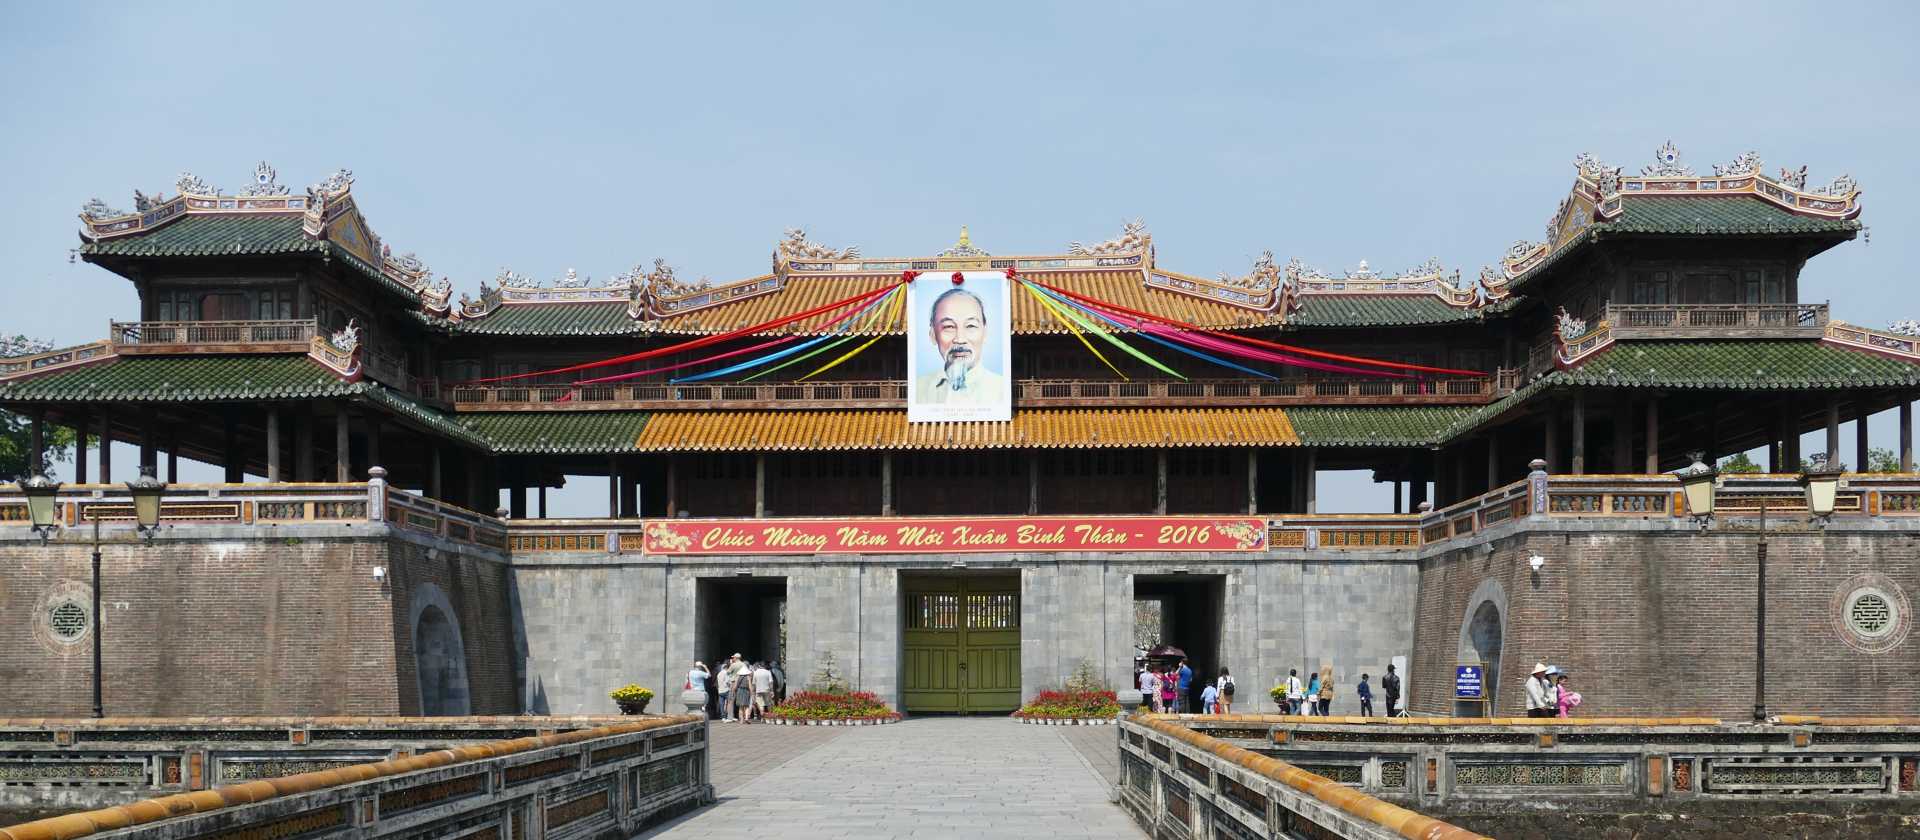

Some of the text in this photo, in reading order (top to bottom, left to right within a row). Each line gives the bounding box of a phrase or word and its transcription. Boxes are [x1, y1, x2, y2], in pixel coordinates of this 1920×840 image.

[702, 527, 755, 549] Chúc
[762, 527, 828, 551] Mừng
[837, 526, 888, 547] Năm
[897, 526, 944, 546] Mới
[952, 526, 1008, 545] Xuân
[1017, 524, 1066, 544] Bính
[1074, 524, 1128, 545] Thân
[1158, 525, 1211, 544] 2016
